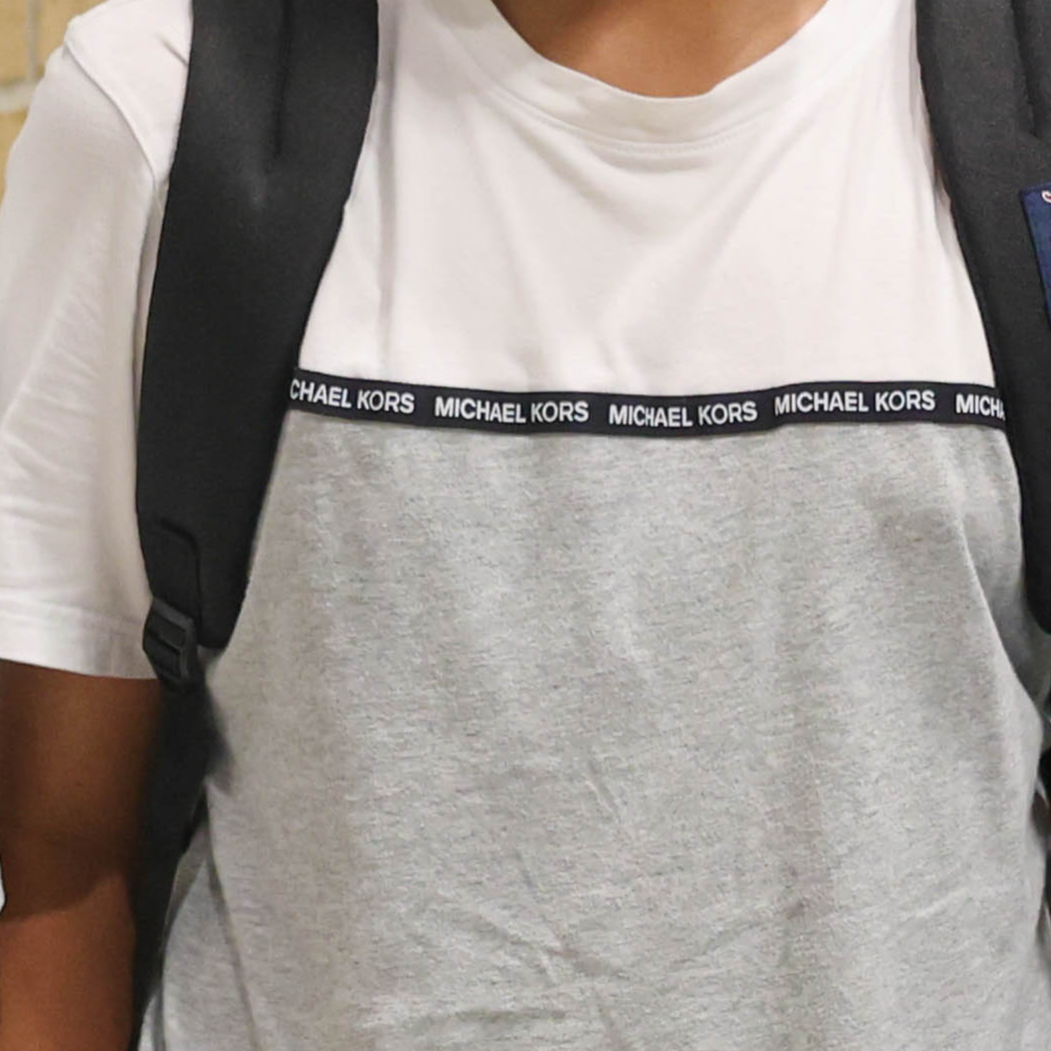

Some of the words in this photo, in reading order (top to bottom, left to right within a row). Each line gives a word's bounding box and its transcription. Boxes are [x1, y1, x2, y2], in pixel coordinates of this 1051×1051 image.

[357, 390, 415, 414] KORS
[435, 396, 526, 424] MICHAEL
[531, 401, 589, 422] KORS
[609, 404, 693, 428] MICHAEL
[698, 401, 758, 425] KORS
[775, 391, 869, 416] MICHAEL
[875, 389, 936, 412] KORS
